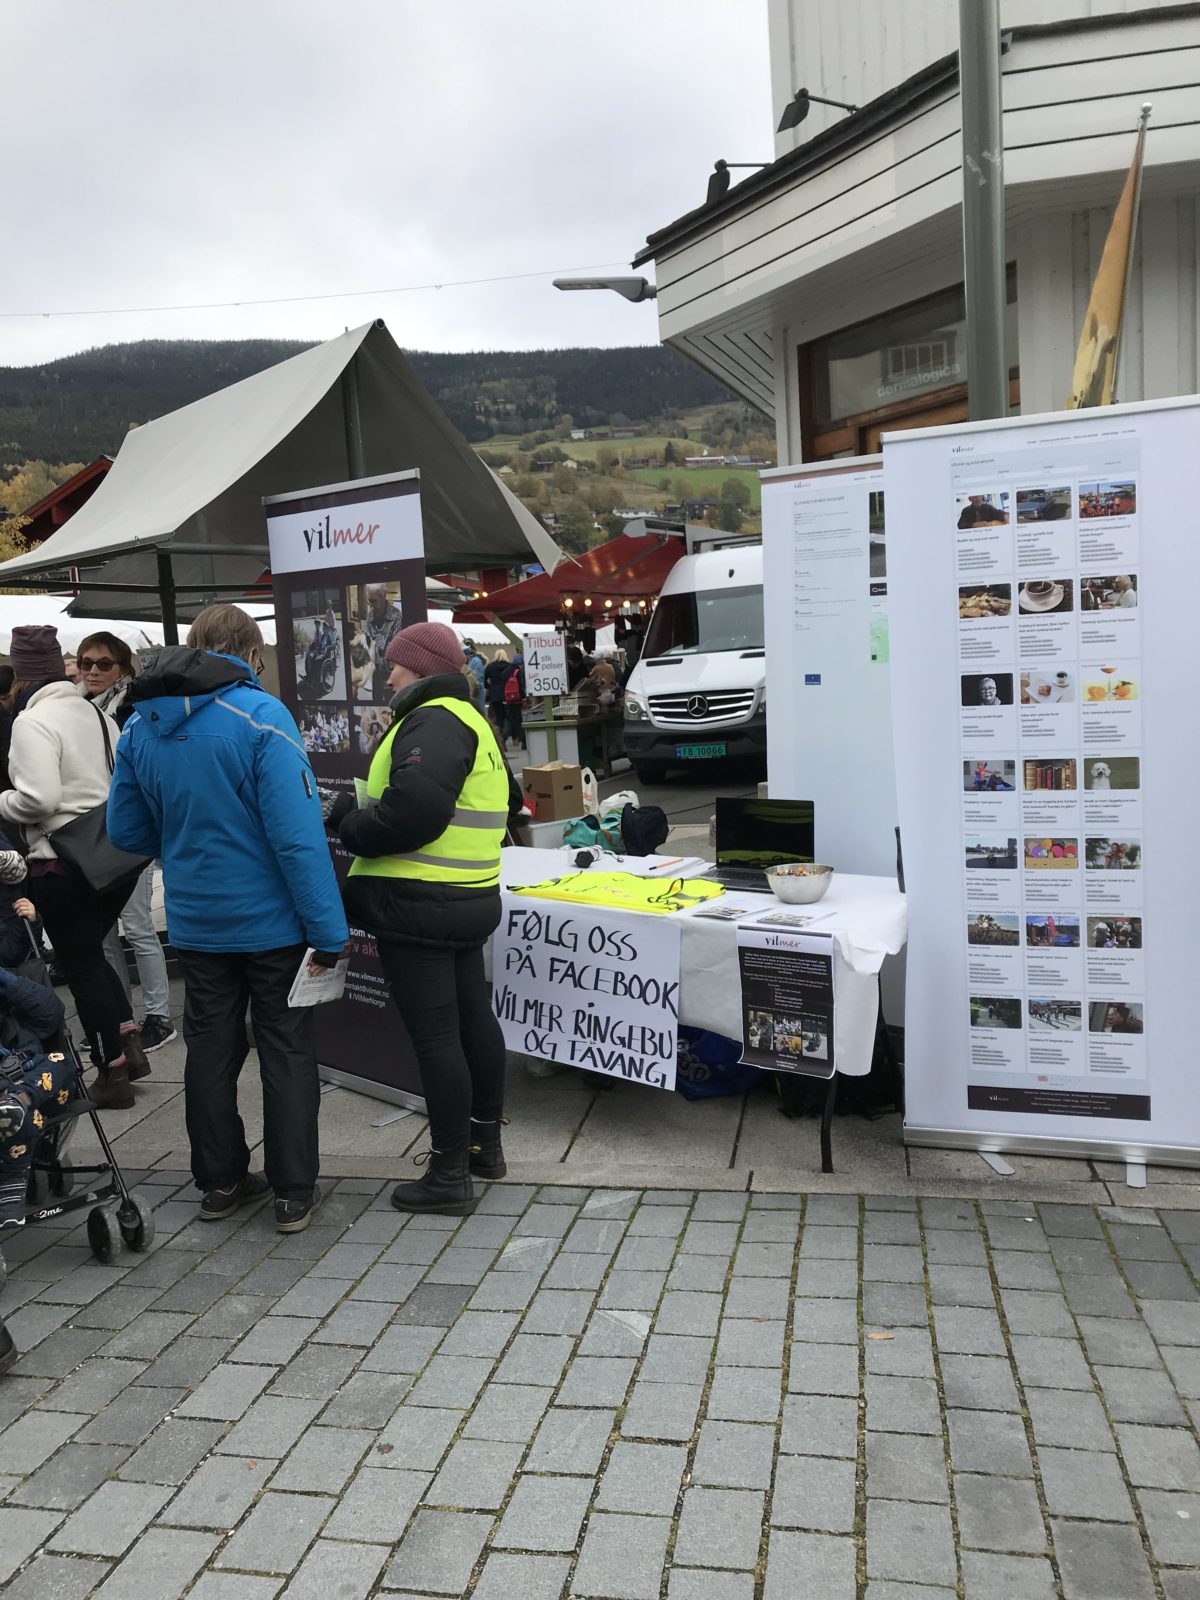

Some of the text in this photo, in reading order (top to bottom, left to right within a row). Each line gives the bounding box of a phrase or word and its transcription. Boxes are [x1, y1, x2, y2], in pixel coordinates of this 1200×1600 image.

[877, 363, 961, 397] dermalogica
[303, 514, 380, 552] vilmer
[526, 636, 562, 649] Tilbud
[528, 650, 540, 670] 4
[697, 746, 723, 756] 10066
[349, 928, 366, 938] som
[507, 910, 638, 961] FØLG OSS
[765, 935, 801, 948] vilmer
[504, 945, 679, 1019] PÅ FACEBOOK
[524, 1029, 557, 1060] OG
